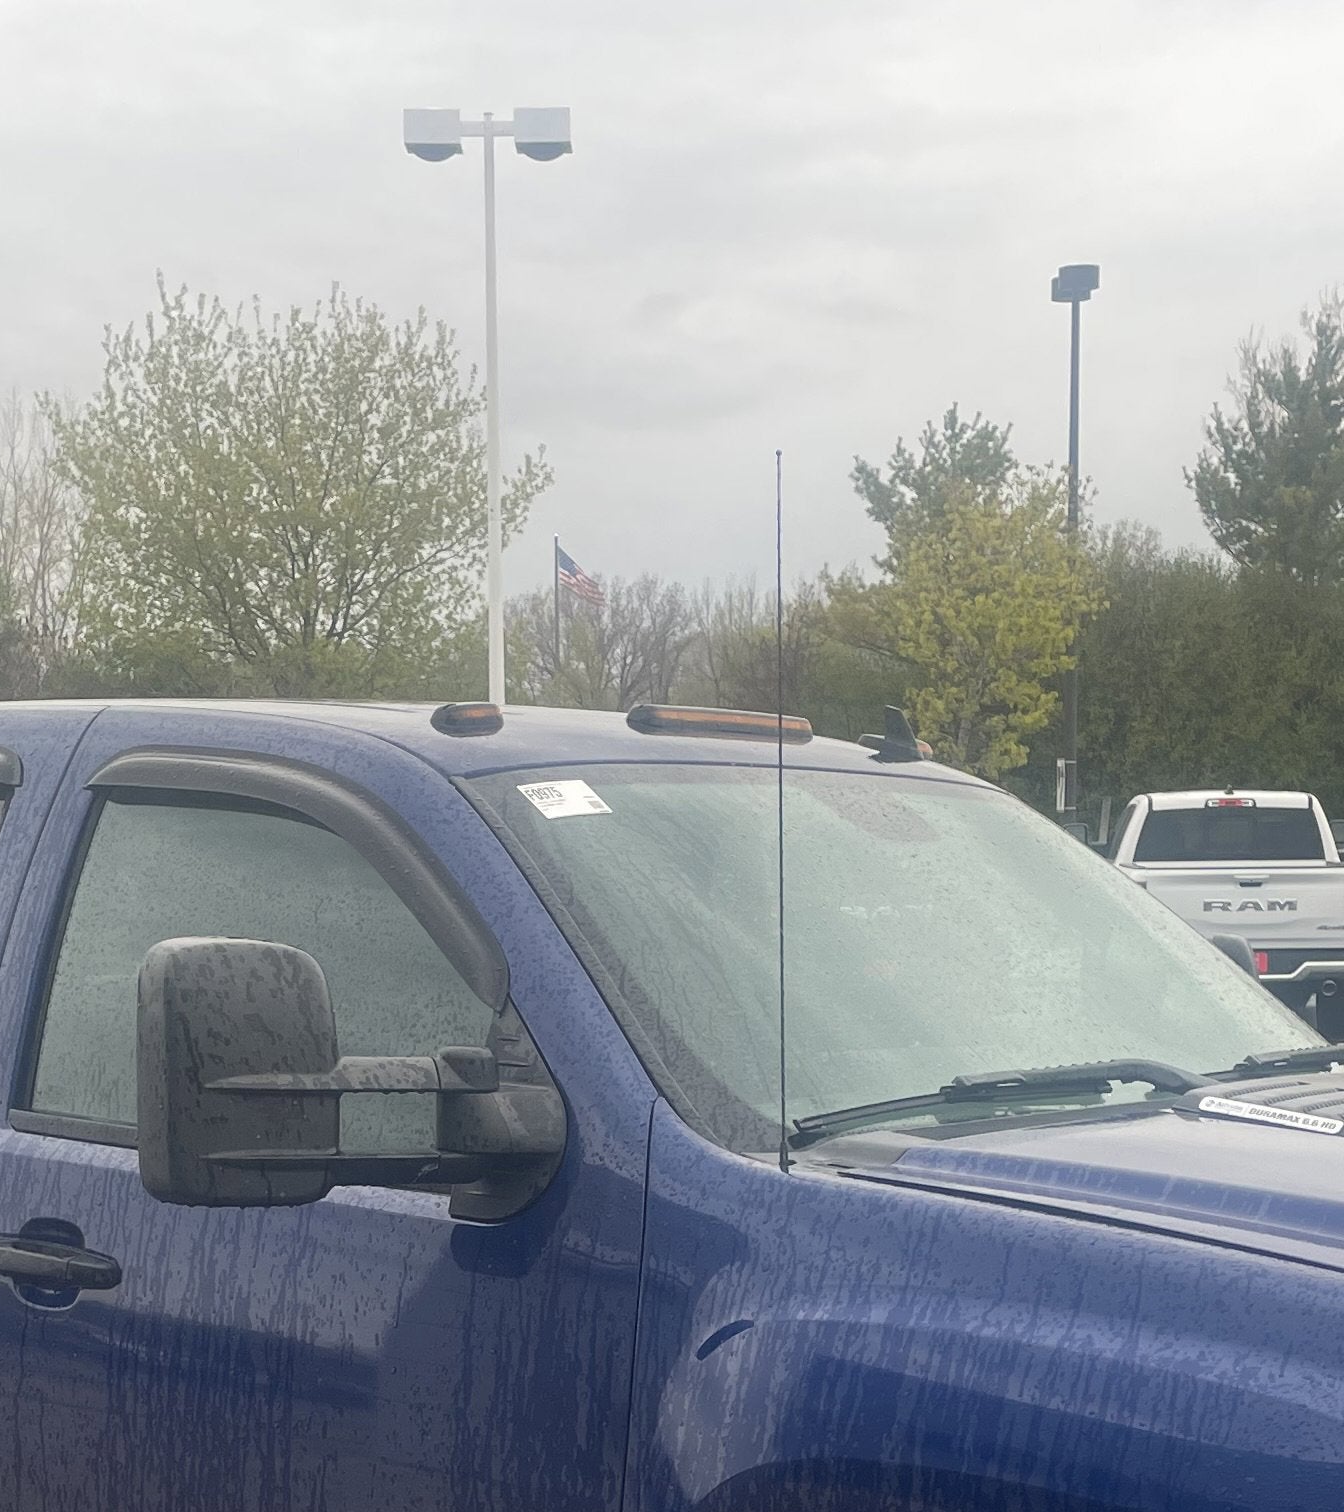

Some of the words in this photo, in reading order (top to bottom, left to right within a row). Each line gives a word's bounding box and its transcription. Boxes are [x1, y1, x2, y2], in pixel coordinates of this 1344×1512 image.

[1203, 898, 1298, 912] RAM
[1248, 1107, 1301, 1124] DURAMAX
[1302, 1117, 1318, 1127] 6.6
[1320, 1121, 1337, 1130] HD
